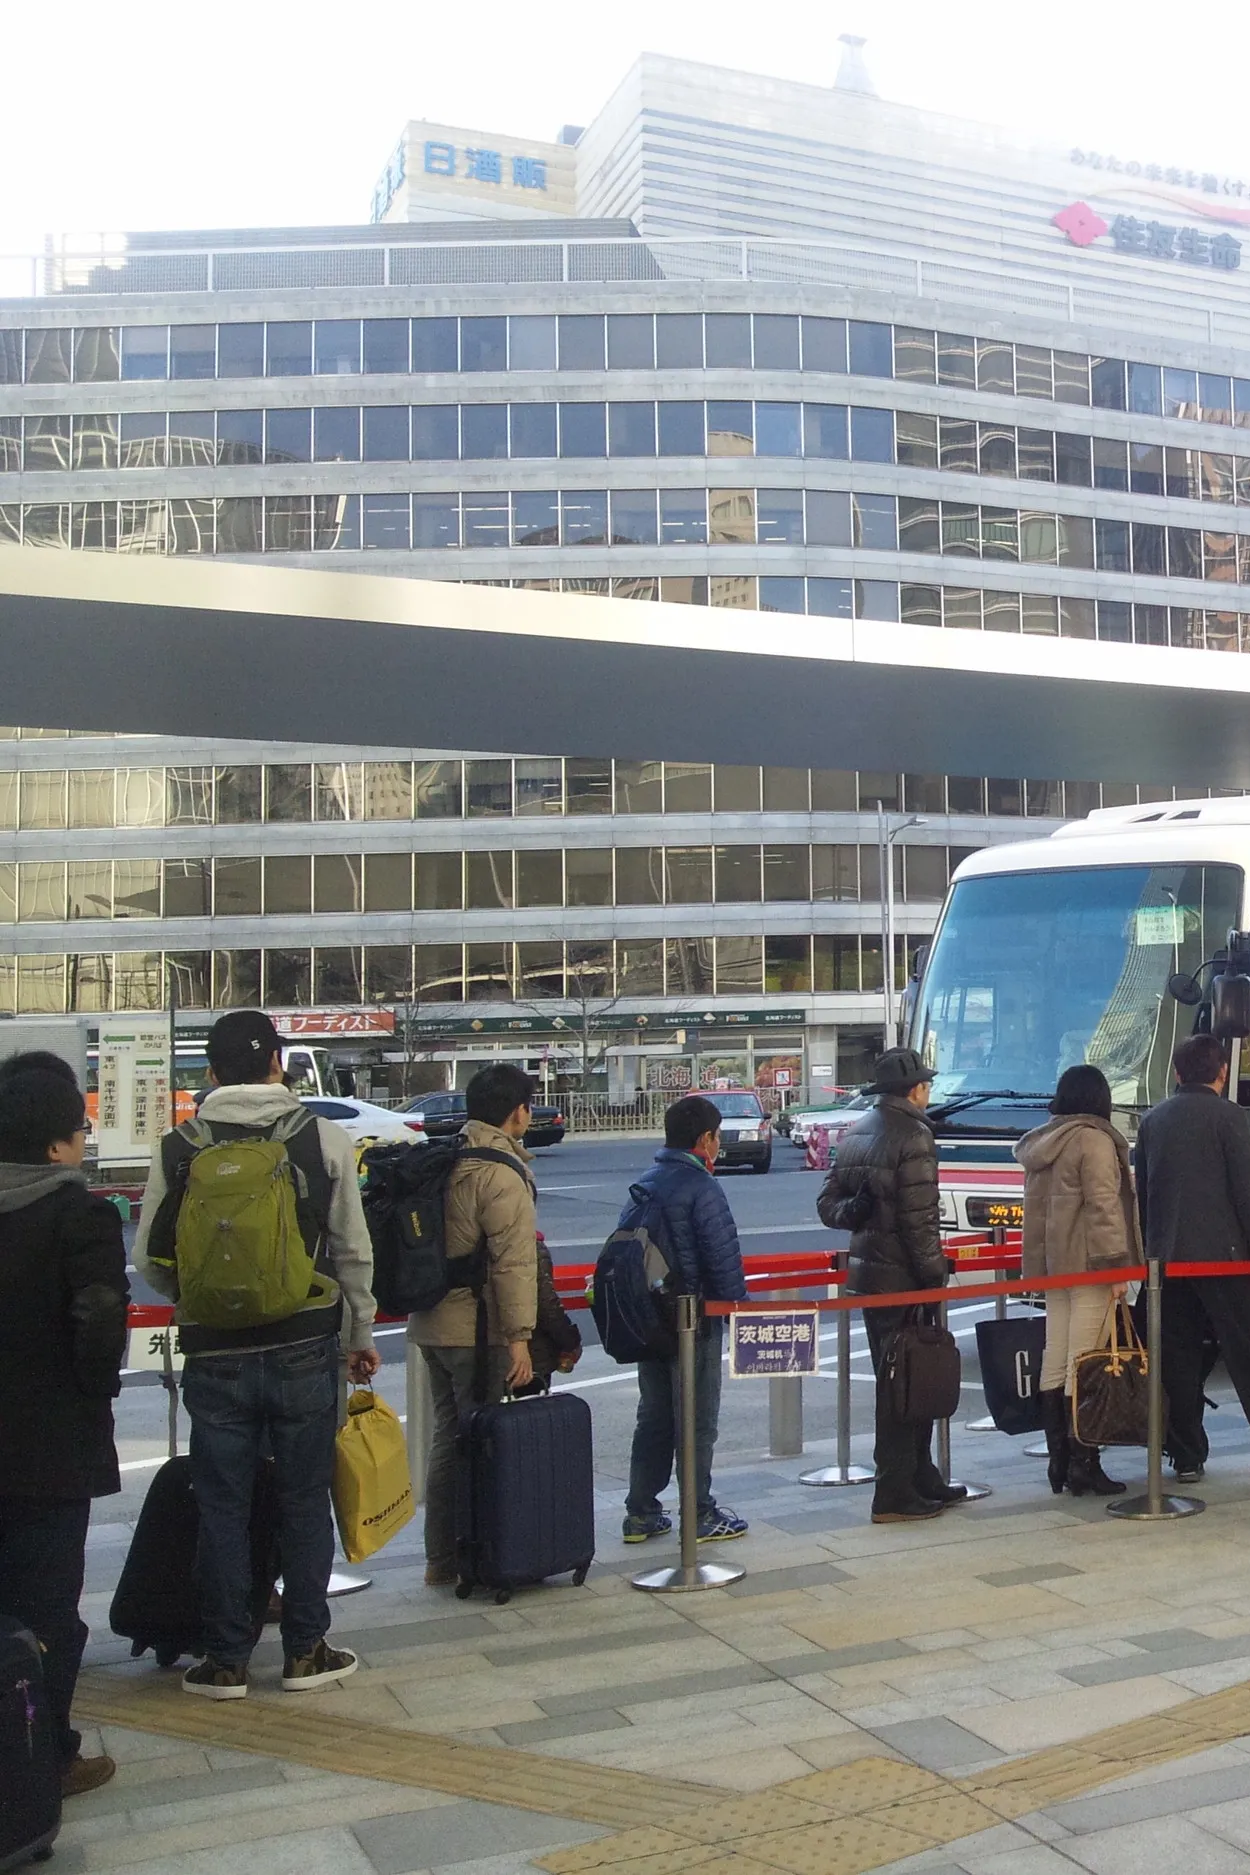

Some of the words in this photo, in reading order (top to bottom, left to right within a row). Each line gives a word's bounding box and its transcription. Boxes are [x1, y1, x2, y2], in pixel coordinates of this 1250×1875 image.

[423, 140, 547, 192] 日酒販
[1112, 213, 1243, 269] 住友生命
[269, 1013, 378, 1033] 道フーディスト
[251, 1040, 260, 1050] 5
[739, 1324, 811, 1344] 茨城空港
[1015, 1350, 1032, 1398] G
